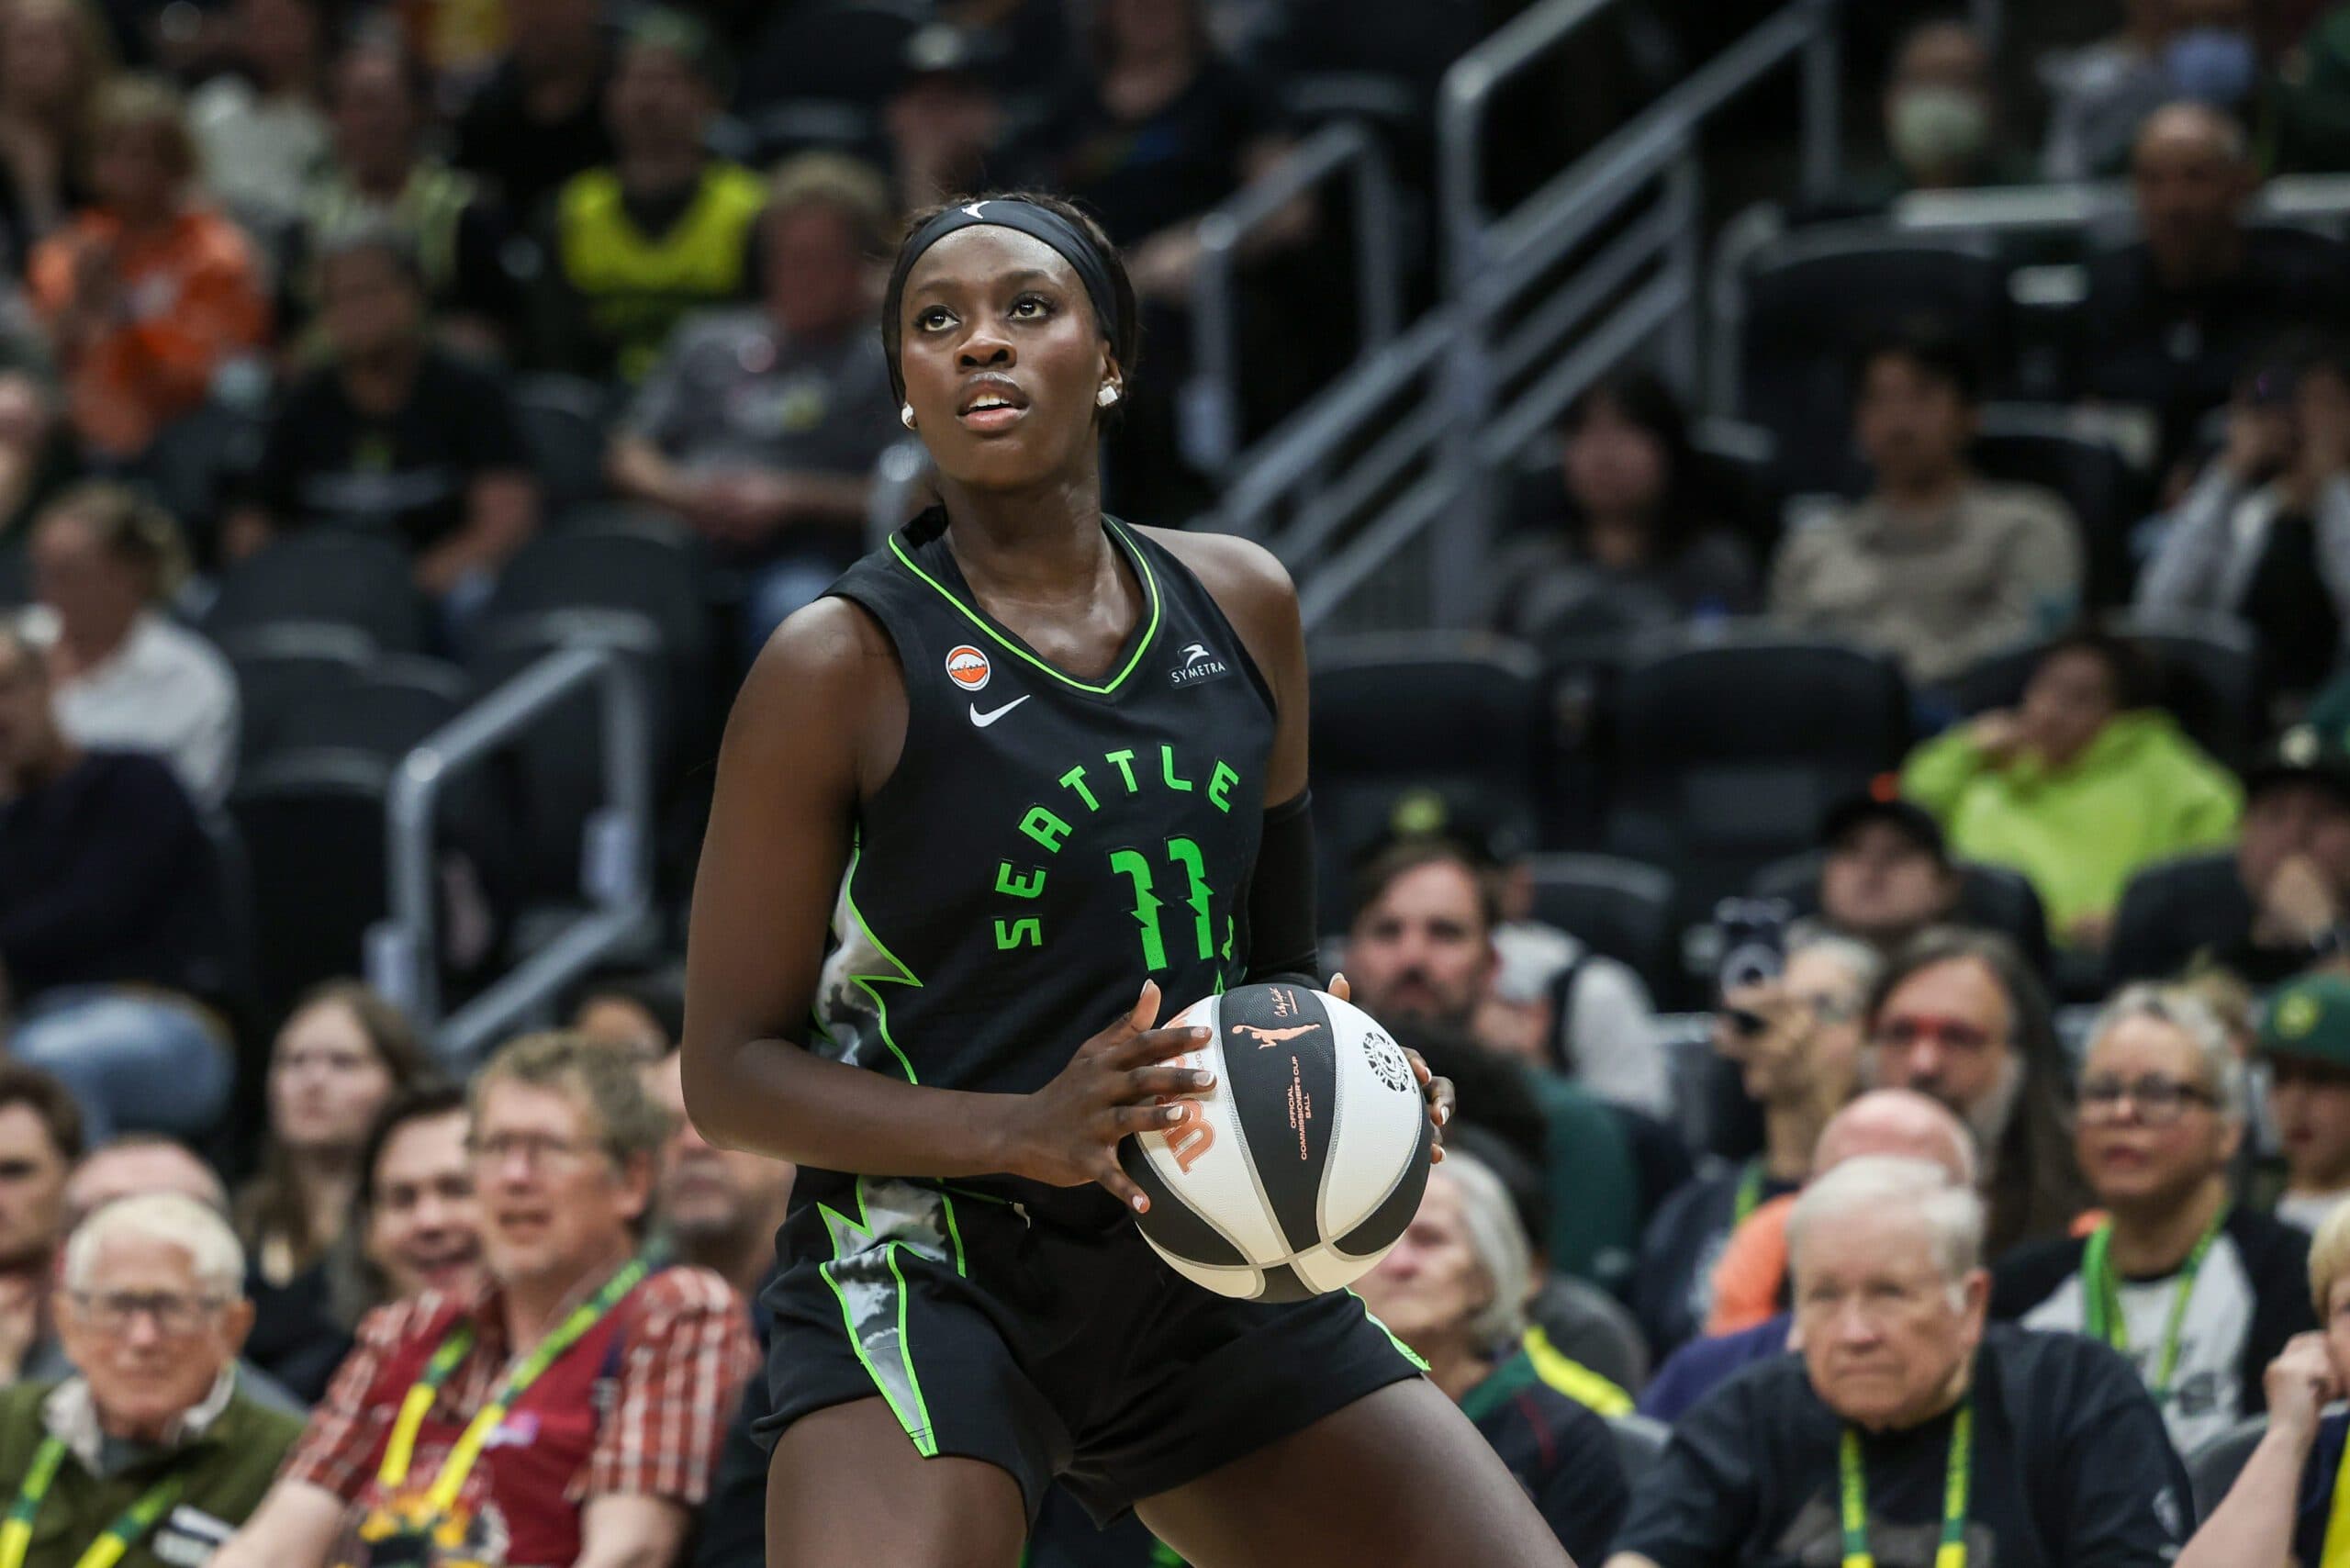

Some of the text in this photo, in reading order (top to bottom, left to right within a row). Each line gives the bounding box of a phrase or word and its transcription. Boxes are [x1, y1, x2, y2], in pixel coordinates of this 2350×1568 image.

[1171, 661, 1225, 683] SYMETRA
[994, 745, 1239, 949] SEATTLE
[1110, 837, 1214, 970] 11
[1287, 1085, 1296, 1129] OFFICIAL
[1293, 1076, 1307, 1160] COMMISSIONER'S
